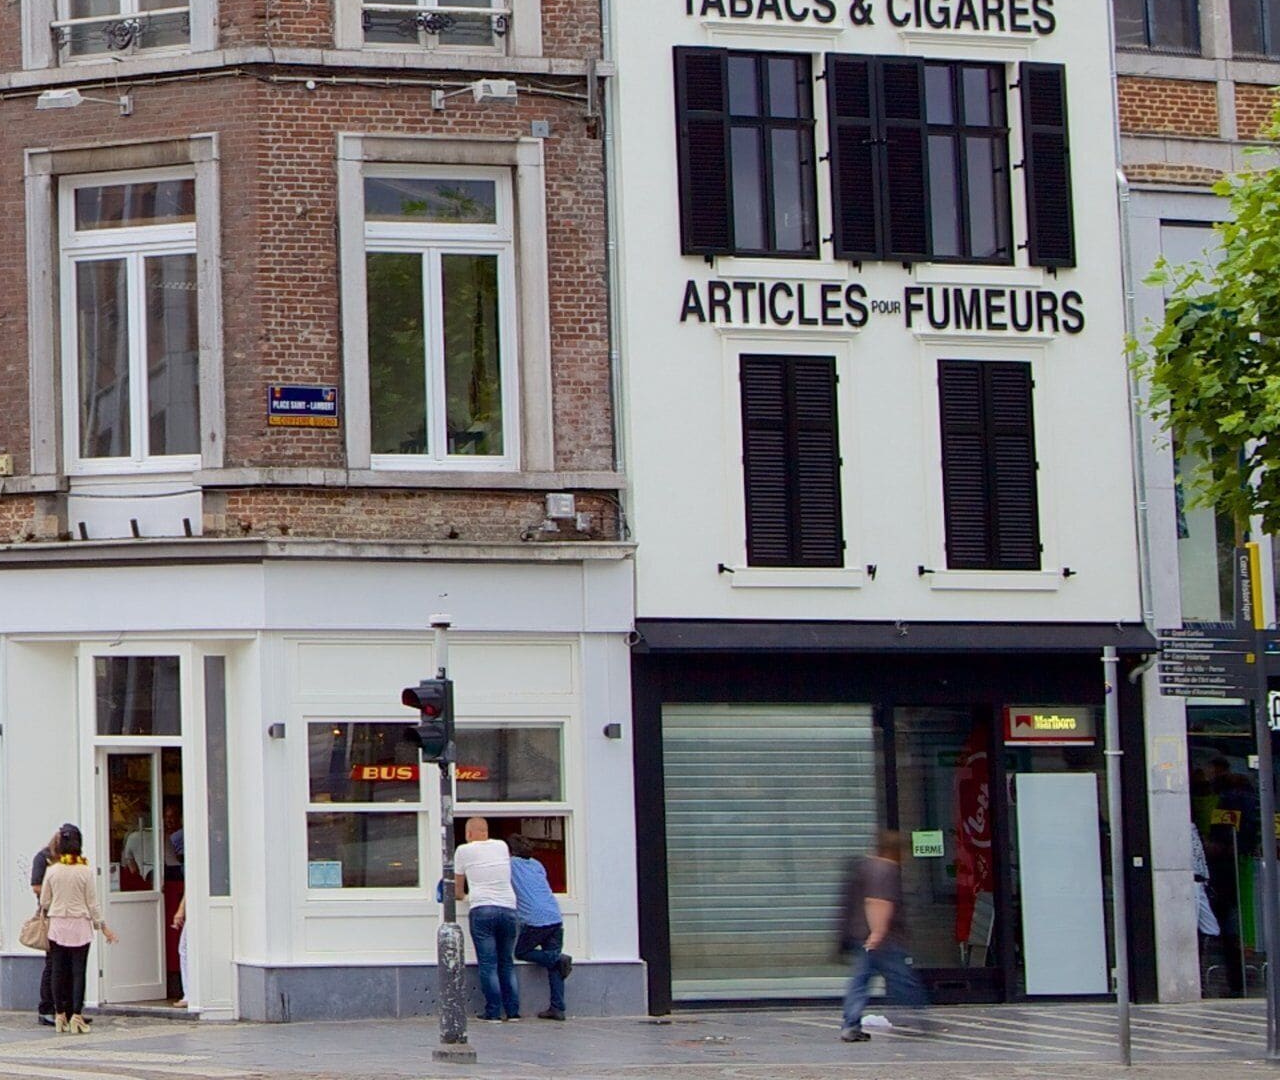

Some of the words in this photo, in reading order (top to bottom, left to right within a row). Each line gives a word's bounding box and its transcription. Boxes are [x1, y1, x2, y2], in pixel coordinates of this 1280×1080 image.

[679, 279, 869, 328] ARTICLES
[871, 300, 902, 315] POUR
[904, 286, 1086, 335] FUMEURS
[272, 400, 289, 410] PLACE
[1034, 715, 1076, 730] Marlboro
[362, 766, 413, 779] BUS
